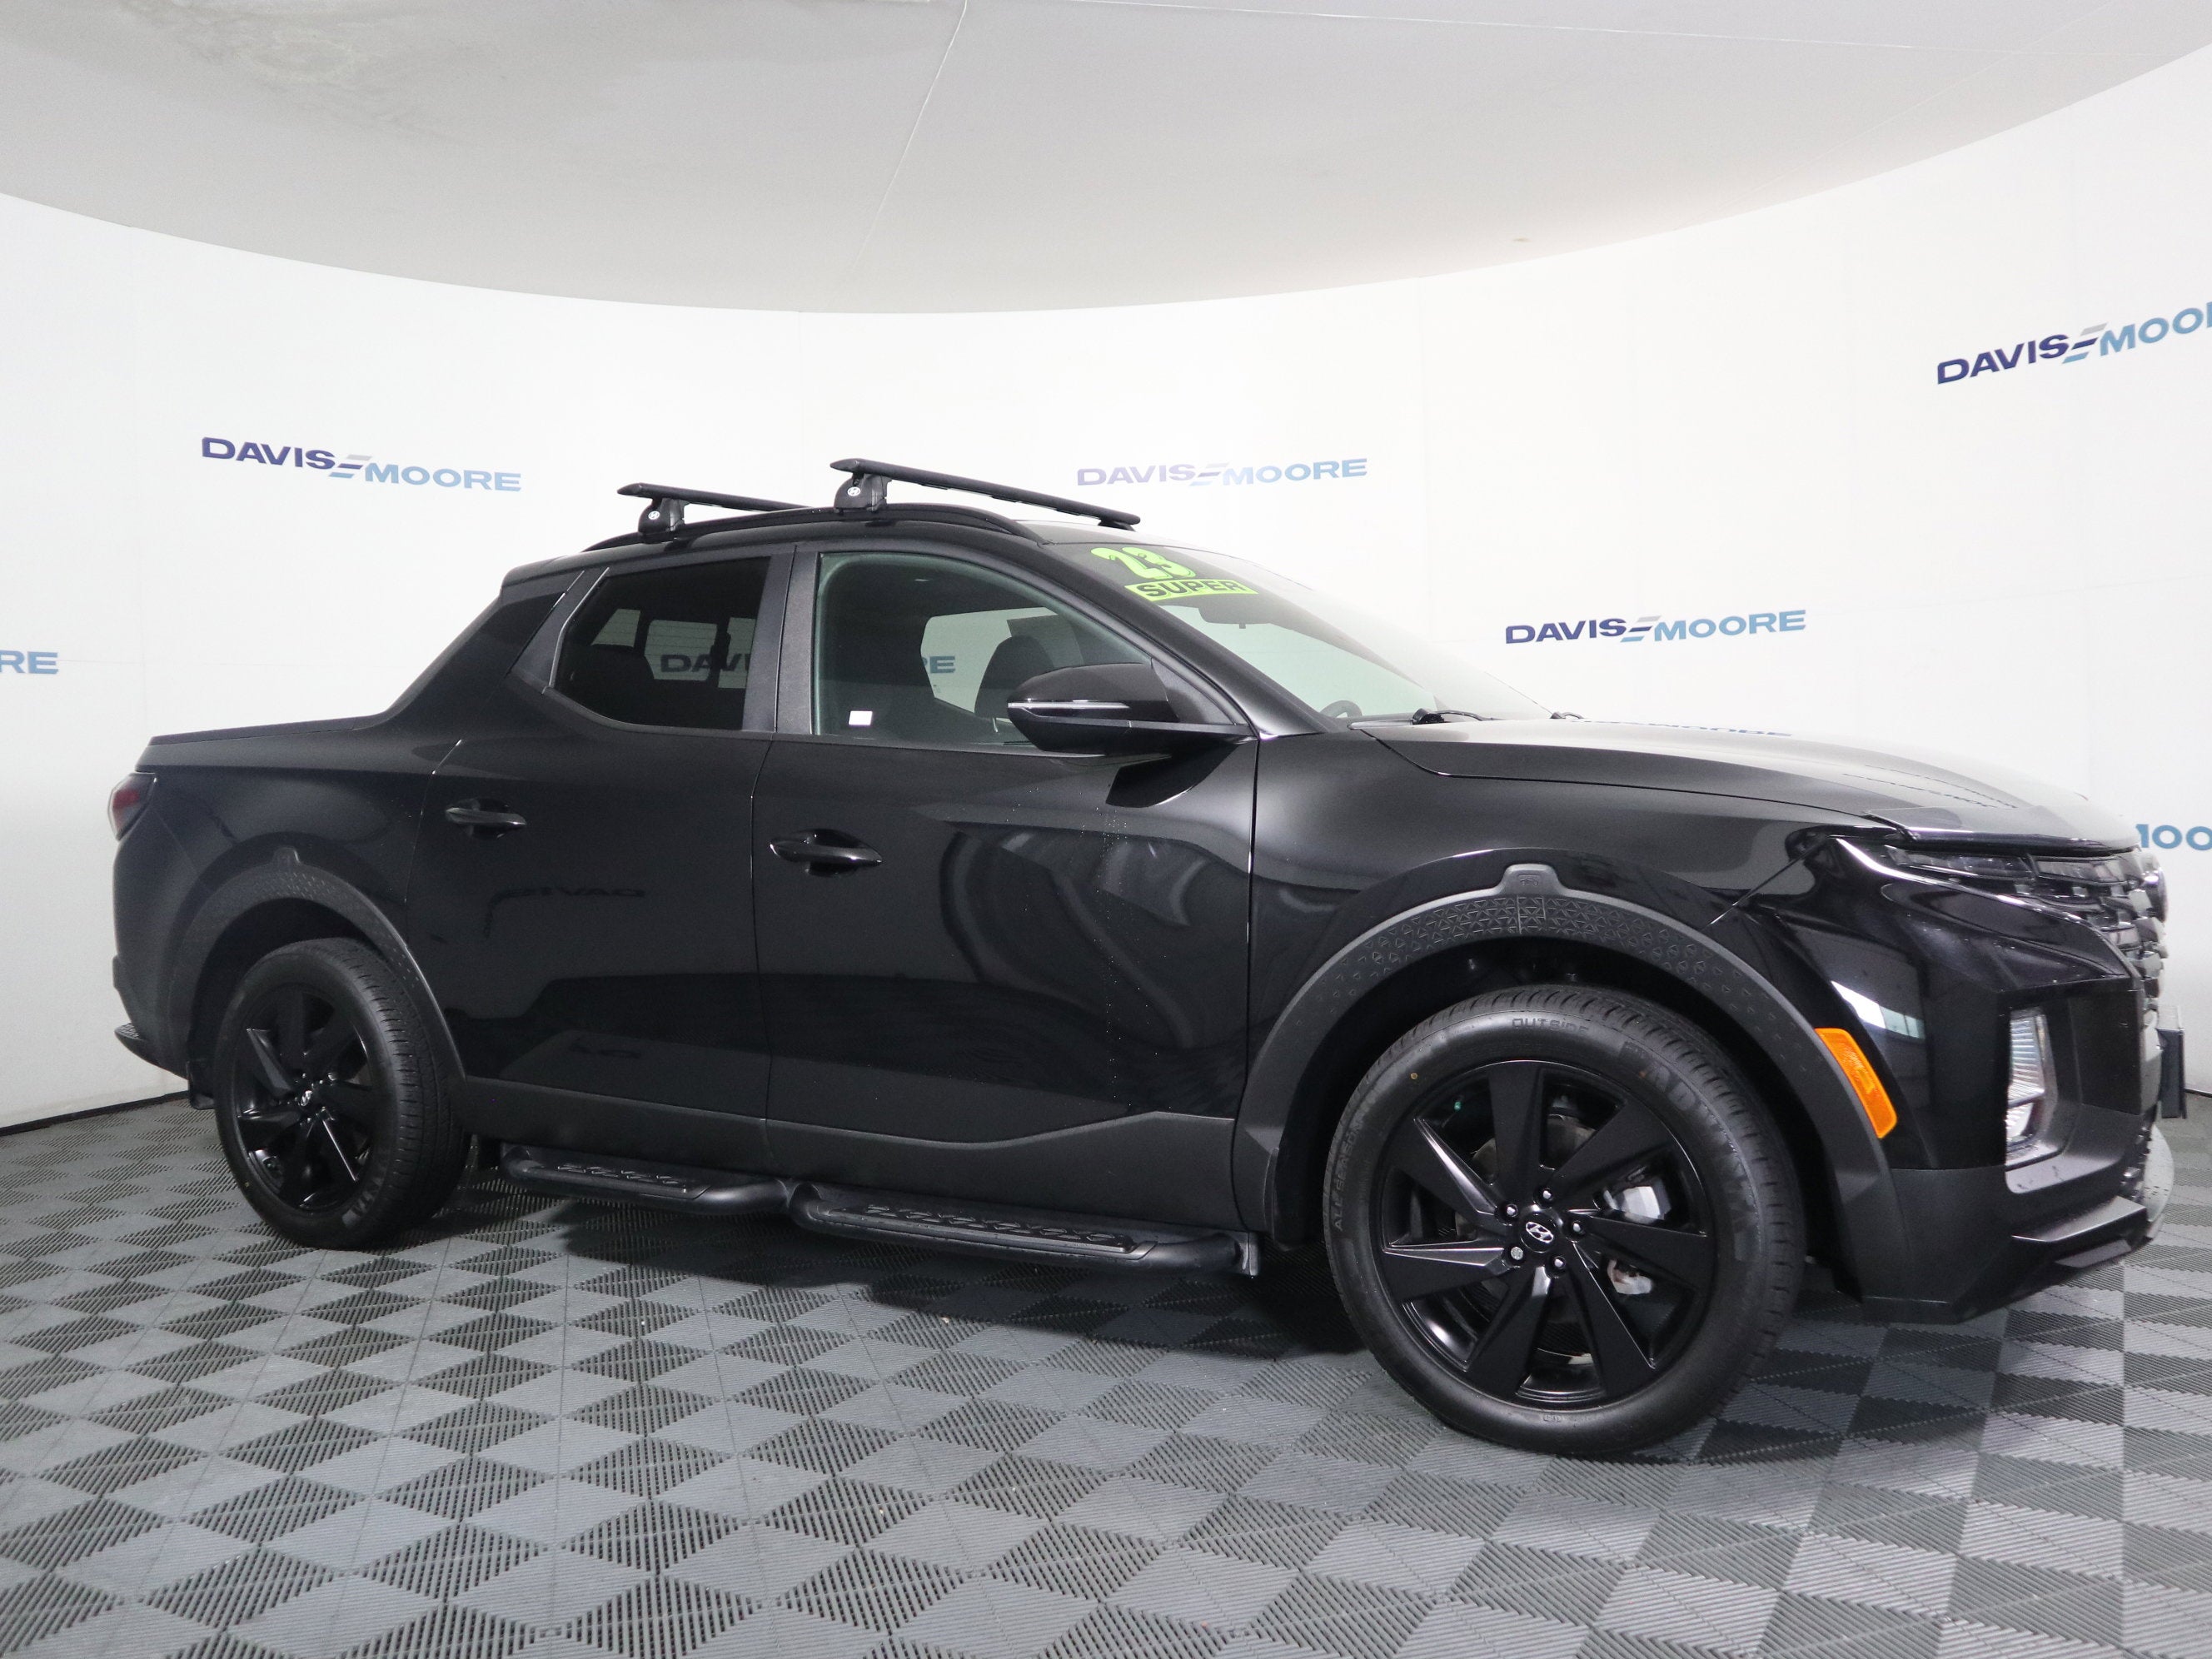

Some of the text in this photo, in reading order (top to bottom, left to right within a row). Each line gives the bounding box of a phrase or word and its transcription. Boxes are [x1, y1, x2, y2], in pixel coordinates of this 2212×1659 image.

[1937, 301, 2212, 385] DAVIS MOO
[202, 436, 521, 491] DAVIS MOORE
[1077, 458, 1368, 486] DAVIS MOORE
[1091, 547, 1196, 580] 23
[1137, 580, 1246, 596] SUPER
[1506, 610, 1806, 644] DAVIS MOORE
